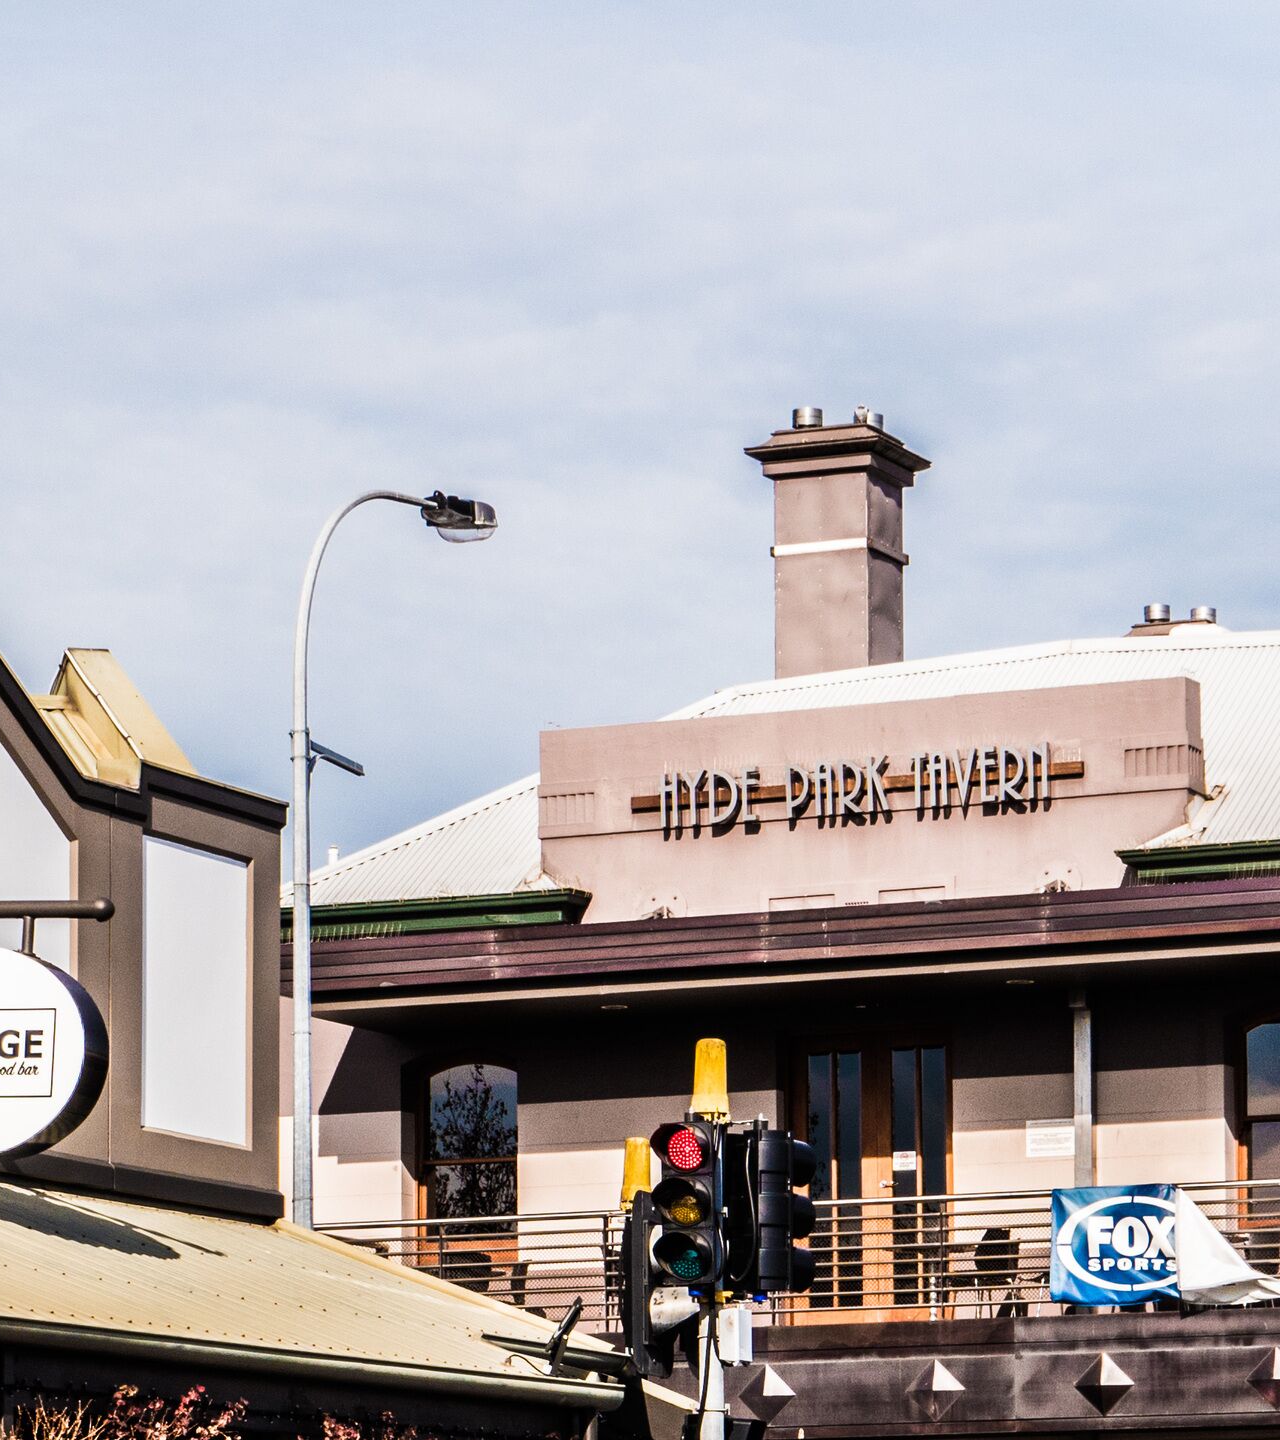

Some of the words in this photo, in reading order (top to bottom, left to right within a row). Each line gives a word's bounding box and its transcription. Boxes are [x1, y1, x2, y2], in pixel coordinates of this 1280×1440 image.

[660, 769, 759, 830] HYDE
[786, 755, 893, 820] PARK
[911, 741, 1051, 821] TAVERN
[17, 1061, 40, 1077] bar
[1087, 1215, 1176, 1259] FOX
[1087, 1257, 1178, 1272] SPORTS
